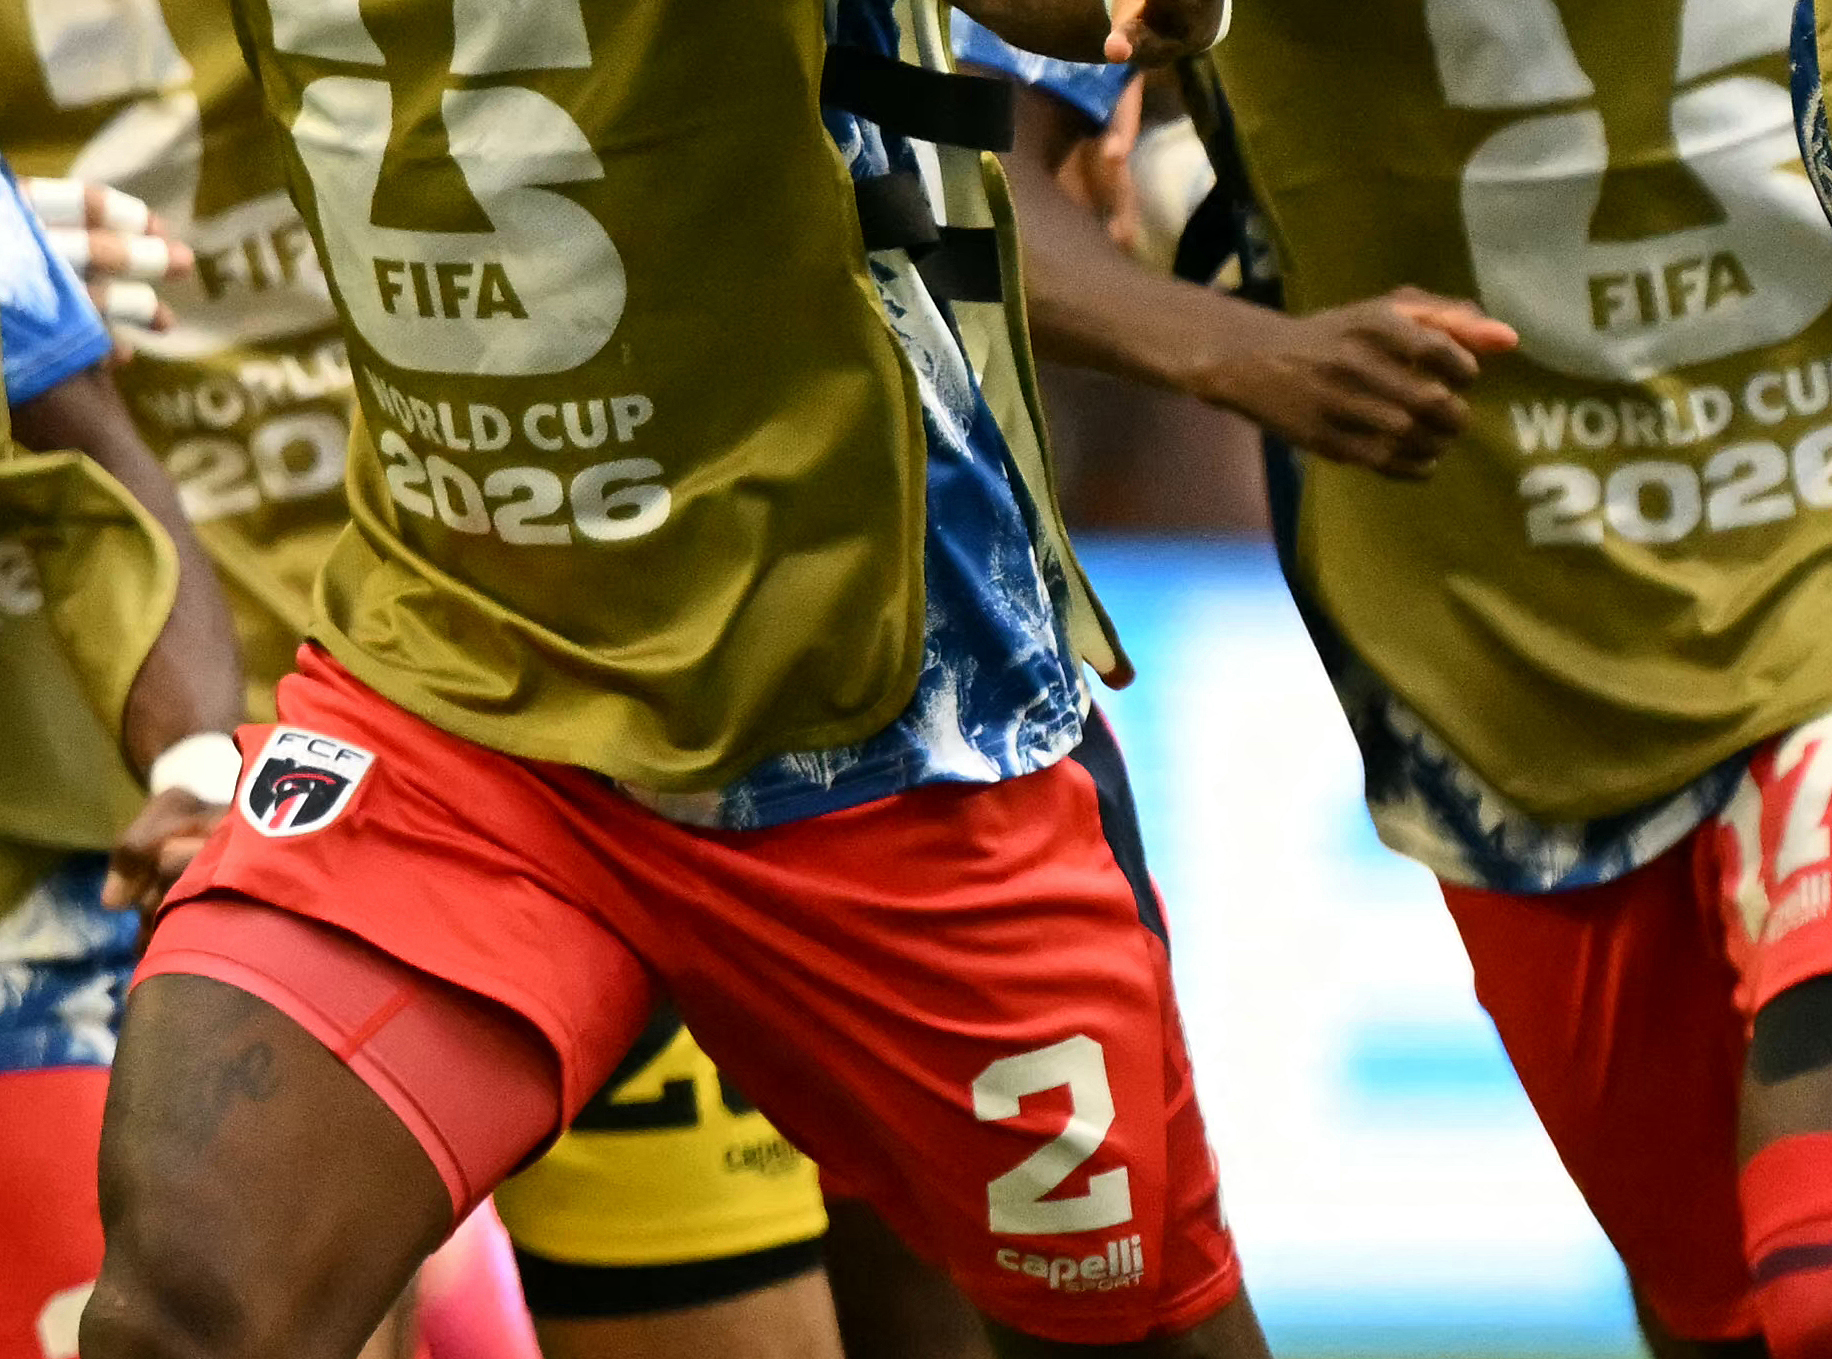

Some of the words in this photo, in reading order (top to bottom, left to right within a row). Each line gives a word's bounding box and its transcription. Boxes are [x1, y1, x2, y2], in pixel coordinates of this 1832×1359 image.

[196, 213, 328, 301] FIF
[373, 256, 530, 320] FIFA
[1588, 250, 1756, 332] FIFA
[362, 363, 513, 453] WORLD
[523, 393, 655, 452] CUP
[1508, 385, 1733, 454] WORLD
[1741, 358, 1832, 426] CU
[165, 411, 352, 526] 20
[380, 429, 673, 546] 2026
[277, 732, 366, 762] FCF
[971, 1033, 1133, 1235] 2
[995, 1233, 1144, 1290] capelli
